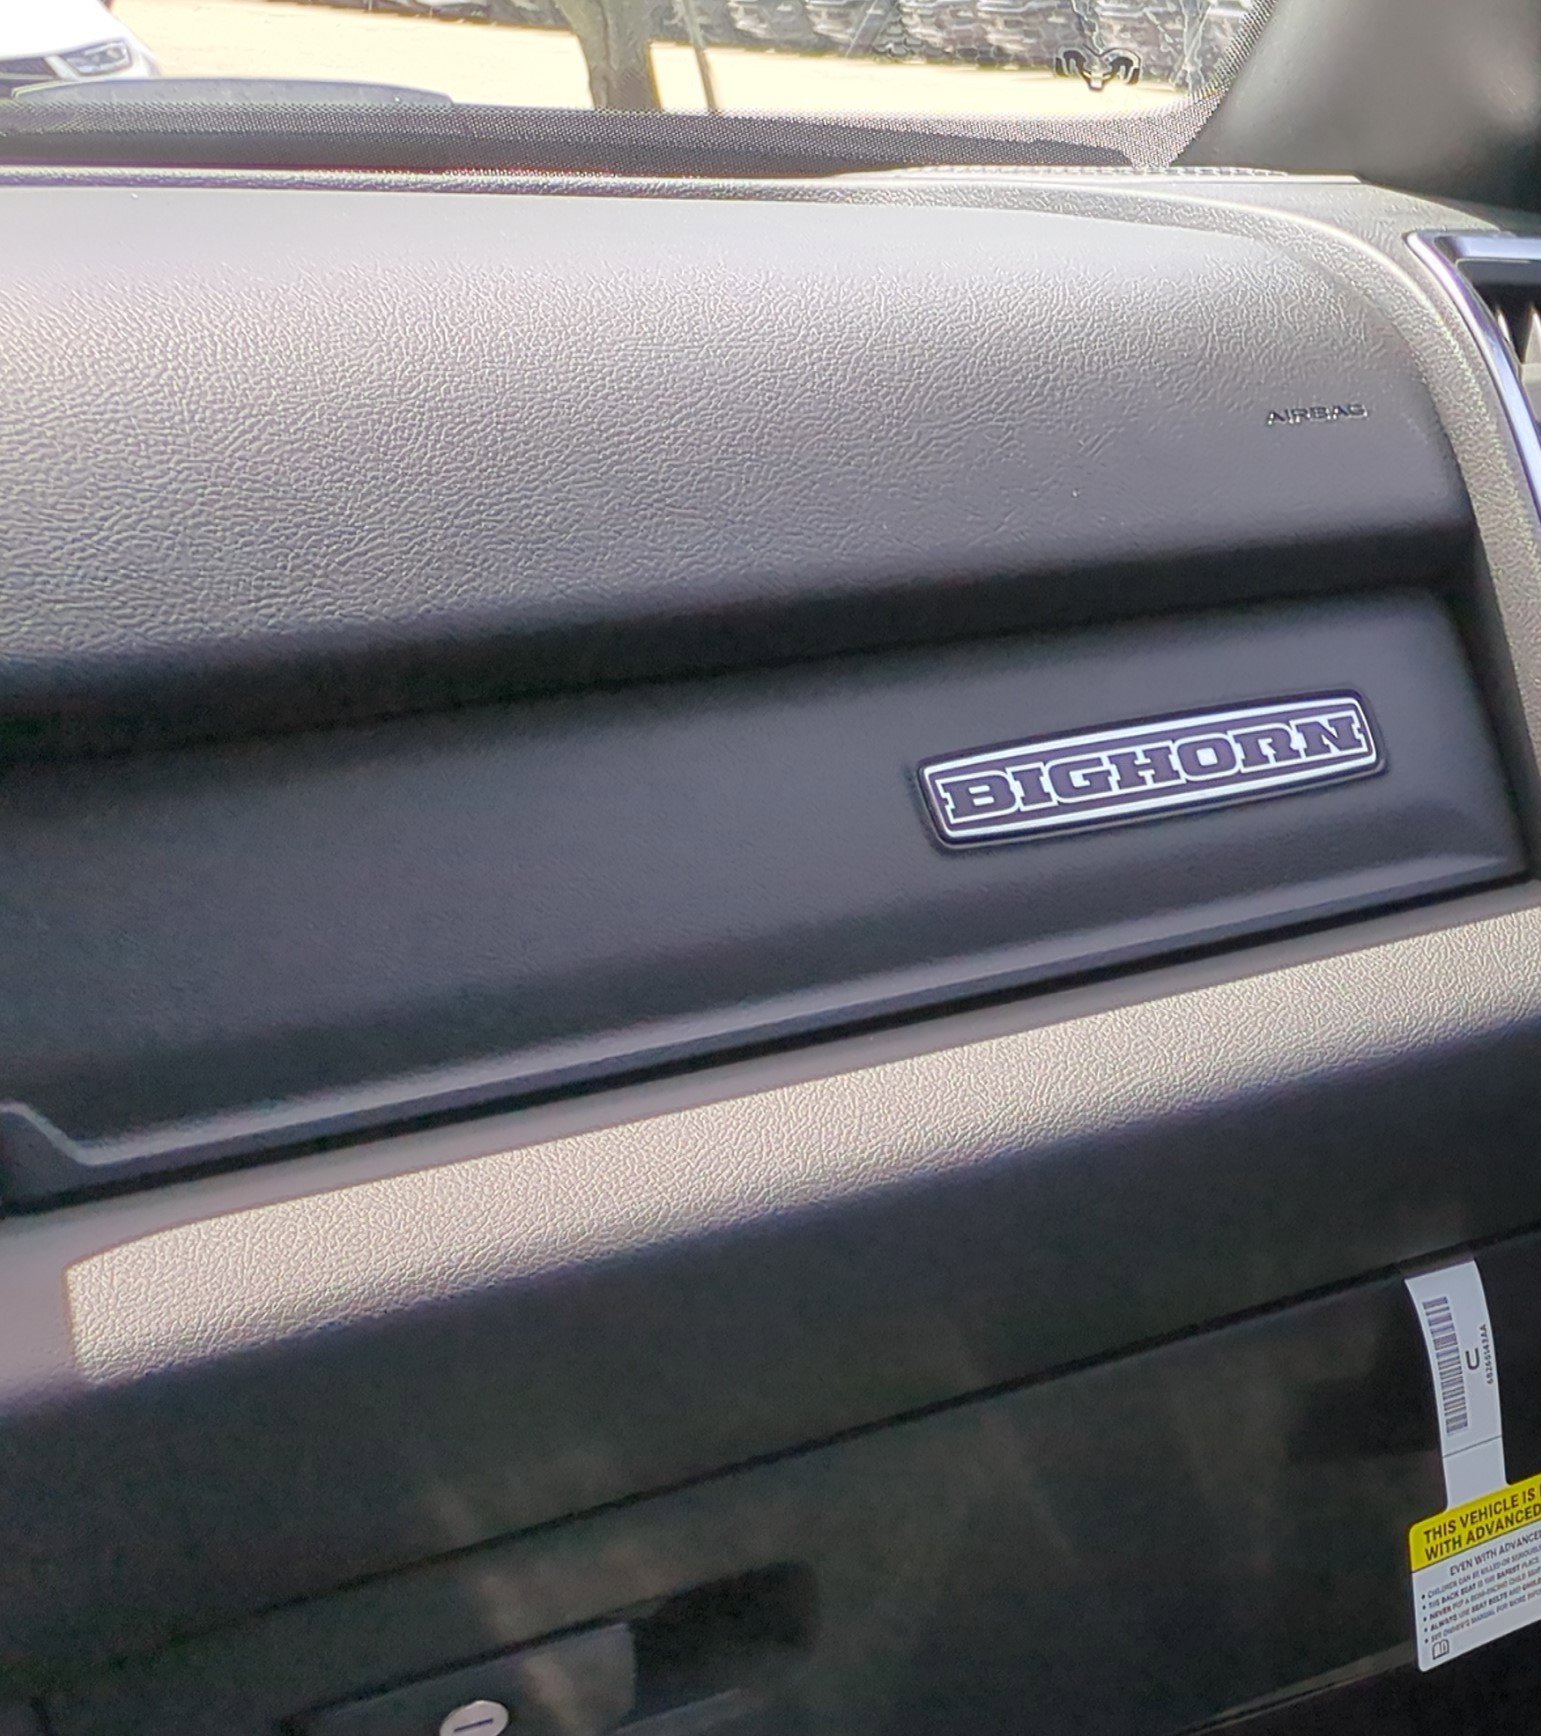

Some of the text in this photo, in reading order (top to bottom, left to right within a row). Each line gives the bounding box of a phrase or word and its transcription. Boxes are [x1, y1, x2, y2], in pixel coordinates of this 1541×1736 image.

[1266, 402, 1369, 425] AIRBAG
[935, 710, 1367, 824] BIGHORN
[1465, 1348, 1480, 1371] U
[1424, 1519, 1456, 1544] THIS
[1459, 1496, 1519, 1528] VEHICLE
[1523, 1488, 1535, 1504] IS
[1425, 1535, 1461, 1562] WITH
[1465, 1504, 1541, 1545] ADVANCED
[1450, 1559, 1472, 1576] EVEN
[1475, 1549, 1497, 1564] WITH
